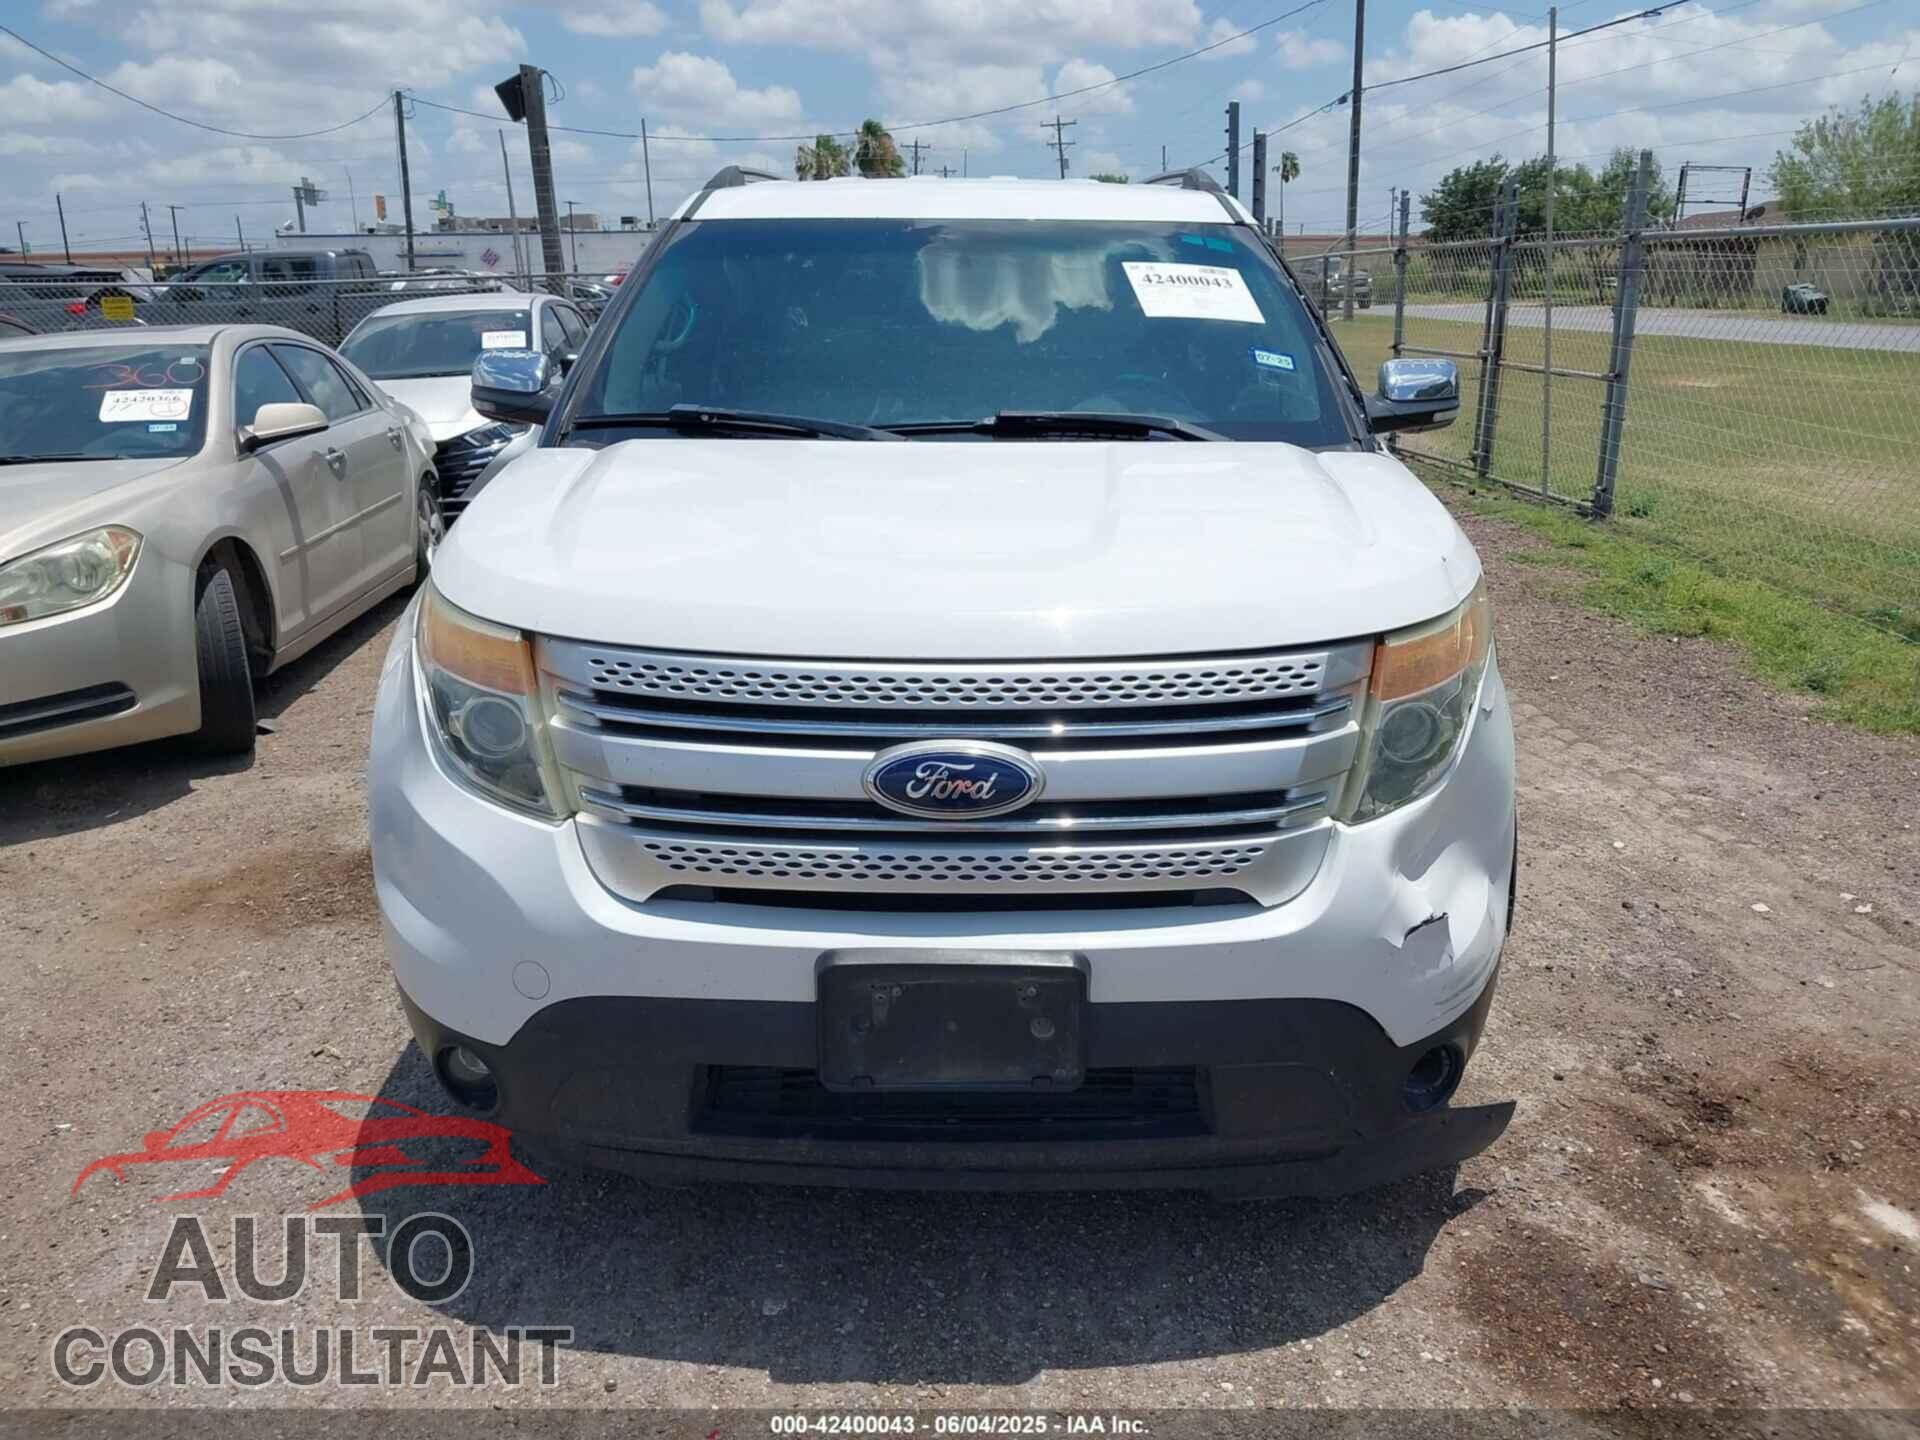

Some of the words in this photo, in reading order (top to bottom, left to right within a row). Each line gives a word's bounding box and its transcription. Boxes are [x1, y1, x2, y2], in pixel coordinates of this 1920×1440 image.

[1142, 273, 1233, 289] 42400043
[81, 360, 205, 388] 360
[906, 761, 999, 799] Ford
